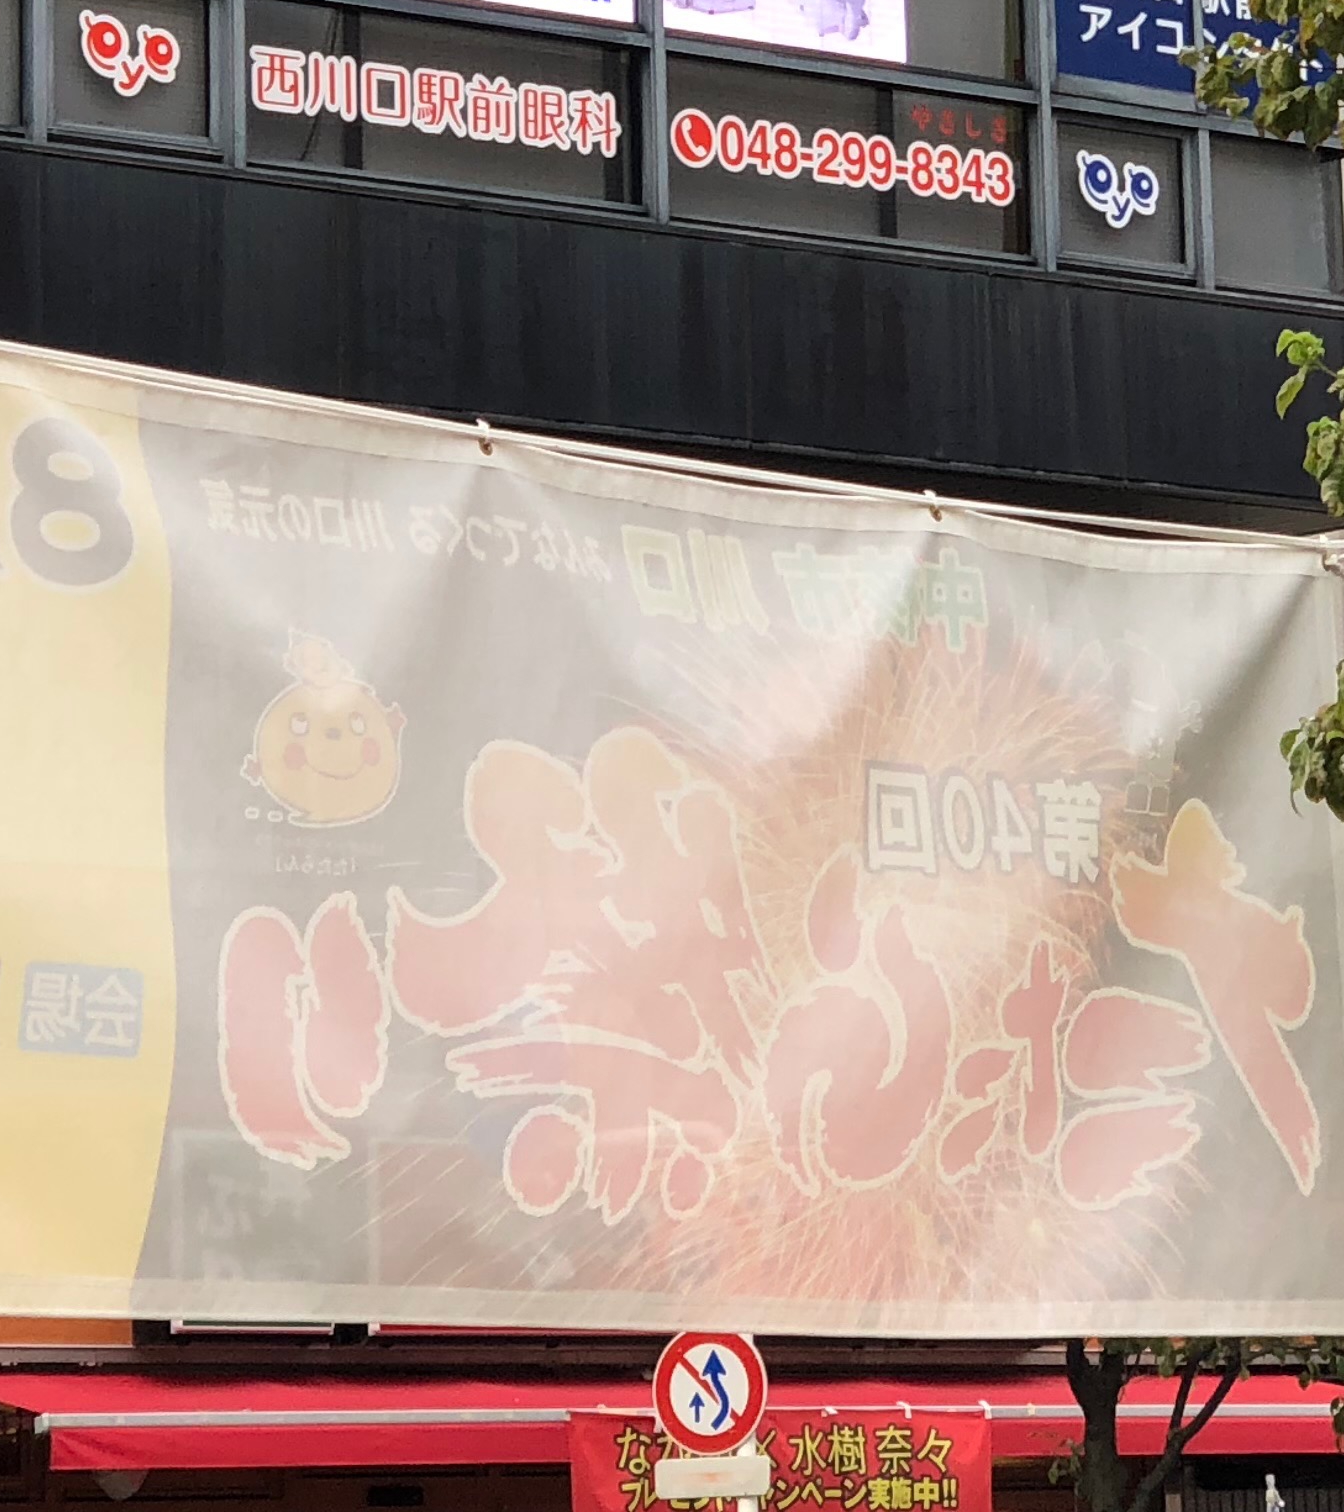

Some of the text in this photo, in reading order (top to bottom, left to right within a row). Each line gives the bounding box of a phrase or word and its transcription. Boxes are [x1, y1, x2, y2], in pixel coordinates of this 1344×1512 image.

[251, 45, 621, 157] 西川口駅前眼科
[718, 115, 1015, 207] 048-299-8343
